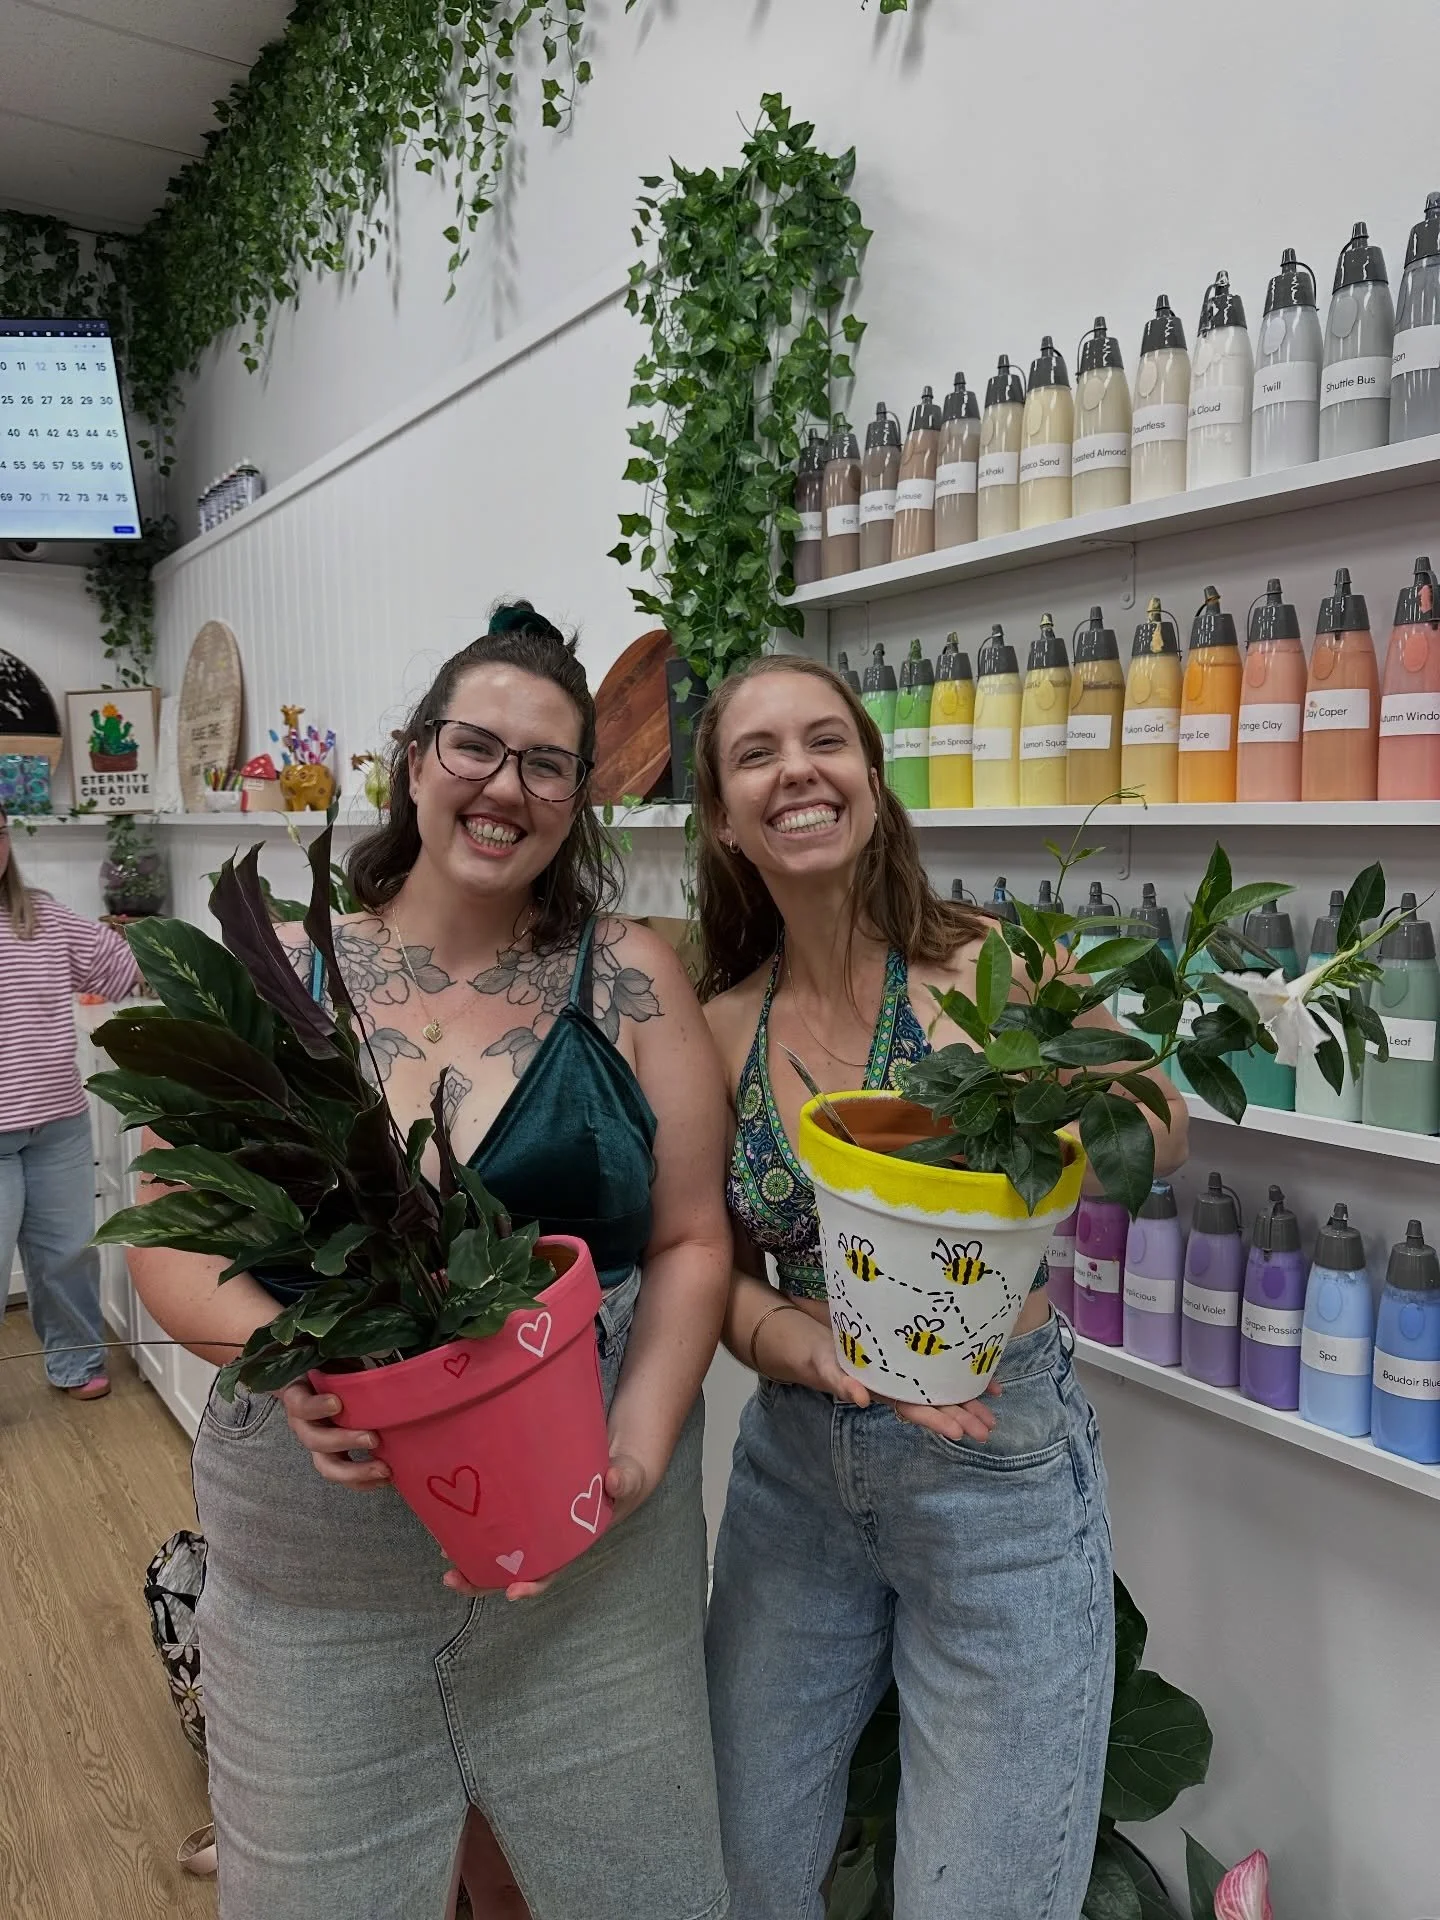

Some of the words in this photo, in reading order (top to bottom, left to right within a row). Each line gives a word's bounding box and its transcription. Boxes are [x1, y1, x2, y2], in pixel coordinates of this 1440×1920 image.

[0, 361, 7, 371] 0
[17, 361, 26, 371] 11
[36, 361, 46, 371] 12
[56, 362, 67, 371] 13
[76, 362, 87, 371] 14
[96, 362, 107, 372] 15
[1262, 381, 1281, 393] Twill
[1326, 378, 1354, 392] Shuttle
[1357, 375, 1376, 385] Bus
[1, 396, 14, 405] 25
[21, 396, 34, 405] 26
[41, 396, 53, 405] 27
[61, 396, 73, 405] 28
[81, 396, 93, 405] 29
[100, 396, 113, 405] 30
[1197, 402, 1221, 414] Cloud
[8, 428, 20, 437] 40
[28, 428, 39, 437] 41
[47, 428, 59, 437] 42
[67, 428, 79, 437] 43
[86, 429, 99, 437] 44
[106, 429, 118, 437] 45
[1097, 448, 1126, 456] Almond
[13, 461, 26, 469] 55
[32, 461, 45, 469] 56
[52, 461, 64, 470] 57
[72, 461, 84, 470] 58
[91, 461, 104, 470] 59
[110, 461, 123, 470] 60
[1039, 458, 1060, 466] Sand
[985, 467, 1004, 476] Khaki
[0, 493, 12, 501] 69
[19, 493, 32, 501] 70
[41, 493, 50, 501] 71
[58, 493, 71, 501] 72
[77, 493, 90, 502] 73
[96, 493, 109, 502] 74
[116, 493, 128, 502] 75
[1319, 707, 1348, 717] Caper
[1406, 711, 1440, 721] Windo
[1144, 723, 1164, 733] Gold
[1262, 720, 1282, 731] Clay
[1196, 731, 1210, 739] Ice
[947, 738, 973, 746] Spread
[1023, 740, 1044, 749] Lemon
[81, 774, 148, 785] ETERNITY
[81, 784, 149, 797] CREATIVE
[108, 797, 125, 806] CO
[1389, 1036, 1411, 1046] Leaf
[1051, 1249, 1067, 1257] Pink
[1086, 1271, 1103, 1281] Pink
[1202, 1303, 1226, 1315] Violet
[1244, 1317, 1267, 1332] Grape
[1319, 1350, 1337, 1362] Spa
[1383, 1369, 1419, 1386] Boudoir
[1422, 1378, 1440, 1388] Blue
